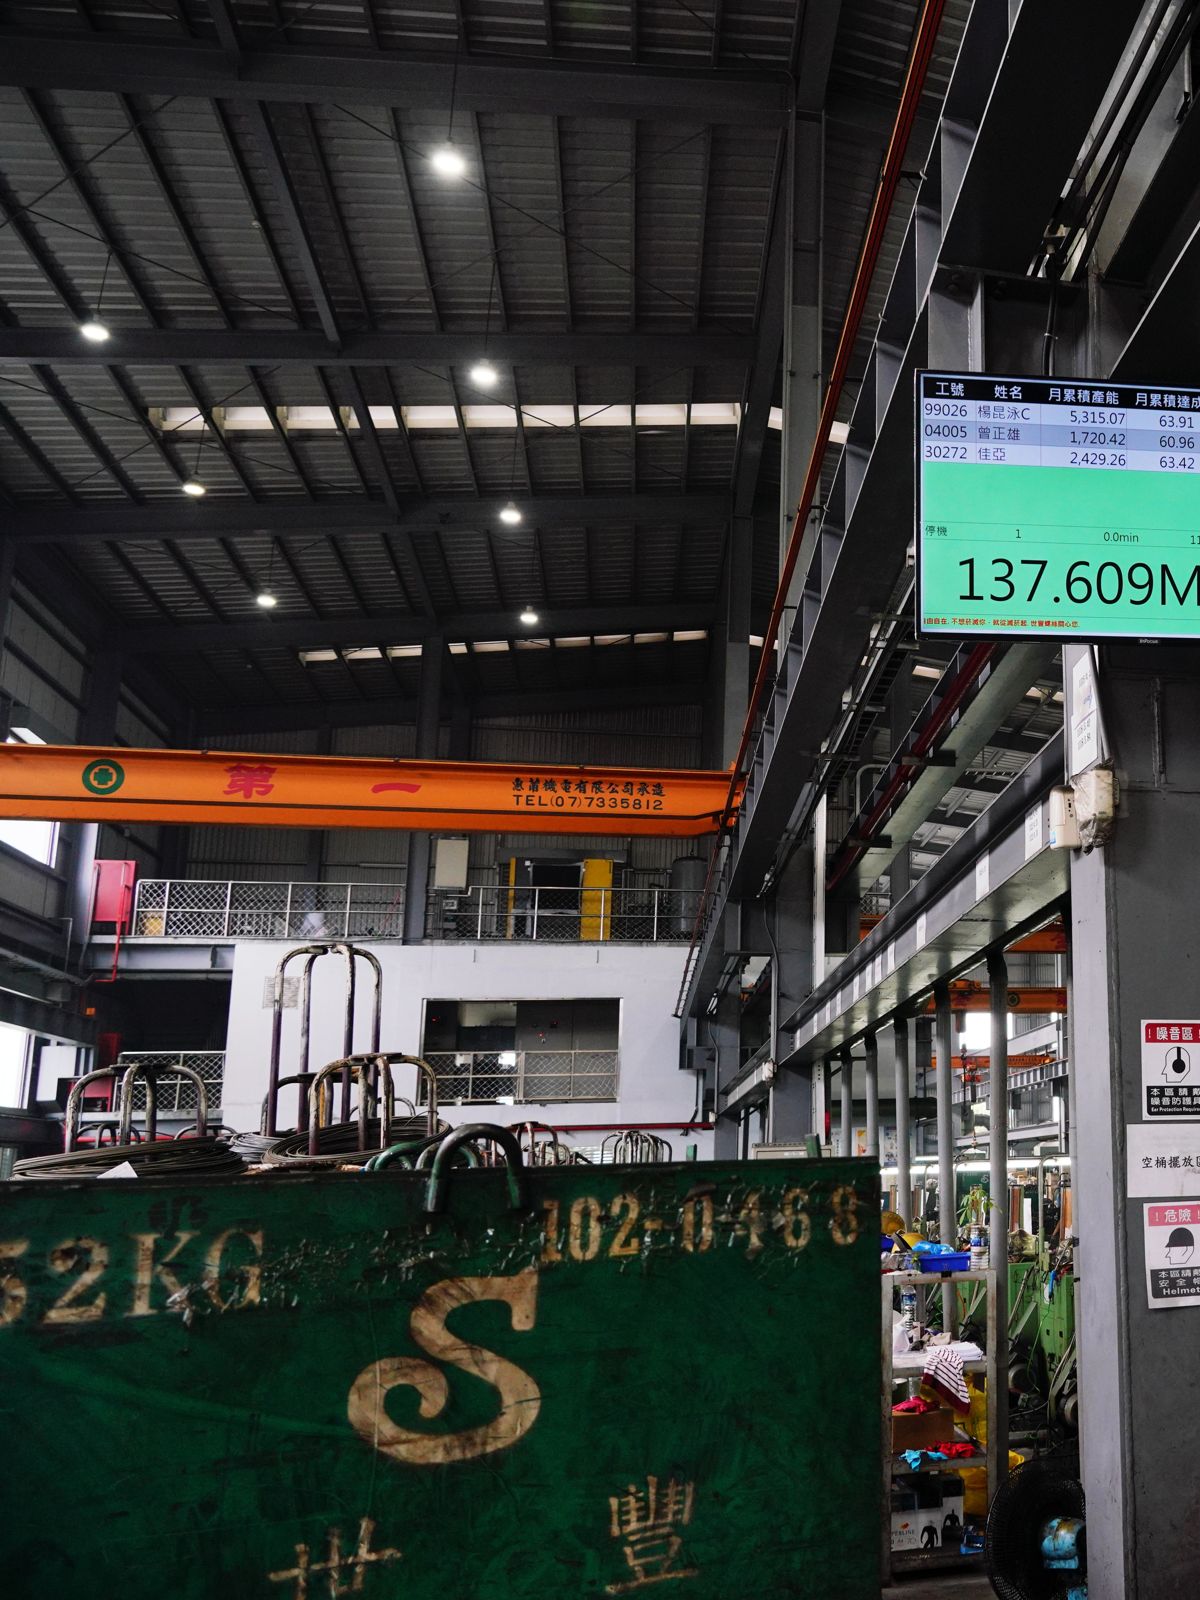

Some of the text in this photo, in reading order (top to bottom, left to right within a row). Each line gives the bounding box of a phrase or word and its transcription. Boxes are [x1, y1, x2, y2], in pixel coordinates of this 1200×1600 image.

[936, 381, 965, 397] 工號
[994, 385, 1023, 400] 姓名
[1049, 387, 1119, 405] 月累積產能
[924, 403, 968, 418] 99026
[1070, 410, 1125, 426] 5,315.07
[1159, 415, 1195, 429] 63.91
[924, 424, 968, 439] 04005
[978, 426, 1021, 442] 曾正雄
[1070, 431, 1126, 447] 1,720.42
[1159, 435, 1195, 449] 60.96
[924, 445, 968, 460] 30272
[977, 447, 1006, 462] 佳亞
[1070, 452, 1126, 468] 2,429.26
[1159, 456, 1195, 470] 63.42
[925, 525, 948, 537] 停機
[1015, 529, 1022, 539] 1
[1103, 531, 1139, 543] 0.0min
[1156, 1026, 1193, 1041] 噪音區
[1164, 1208, 1192, 1223] 危險
[0, 1227, 265, 1327] 52KG
[1163, 1286, 1200, 1296] Helmet
[347, 1264, 542, 1465] S
